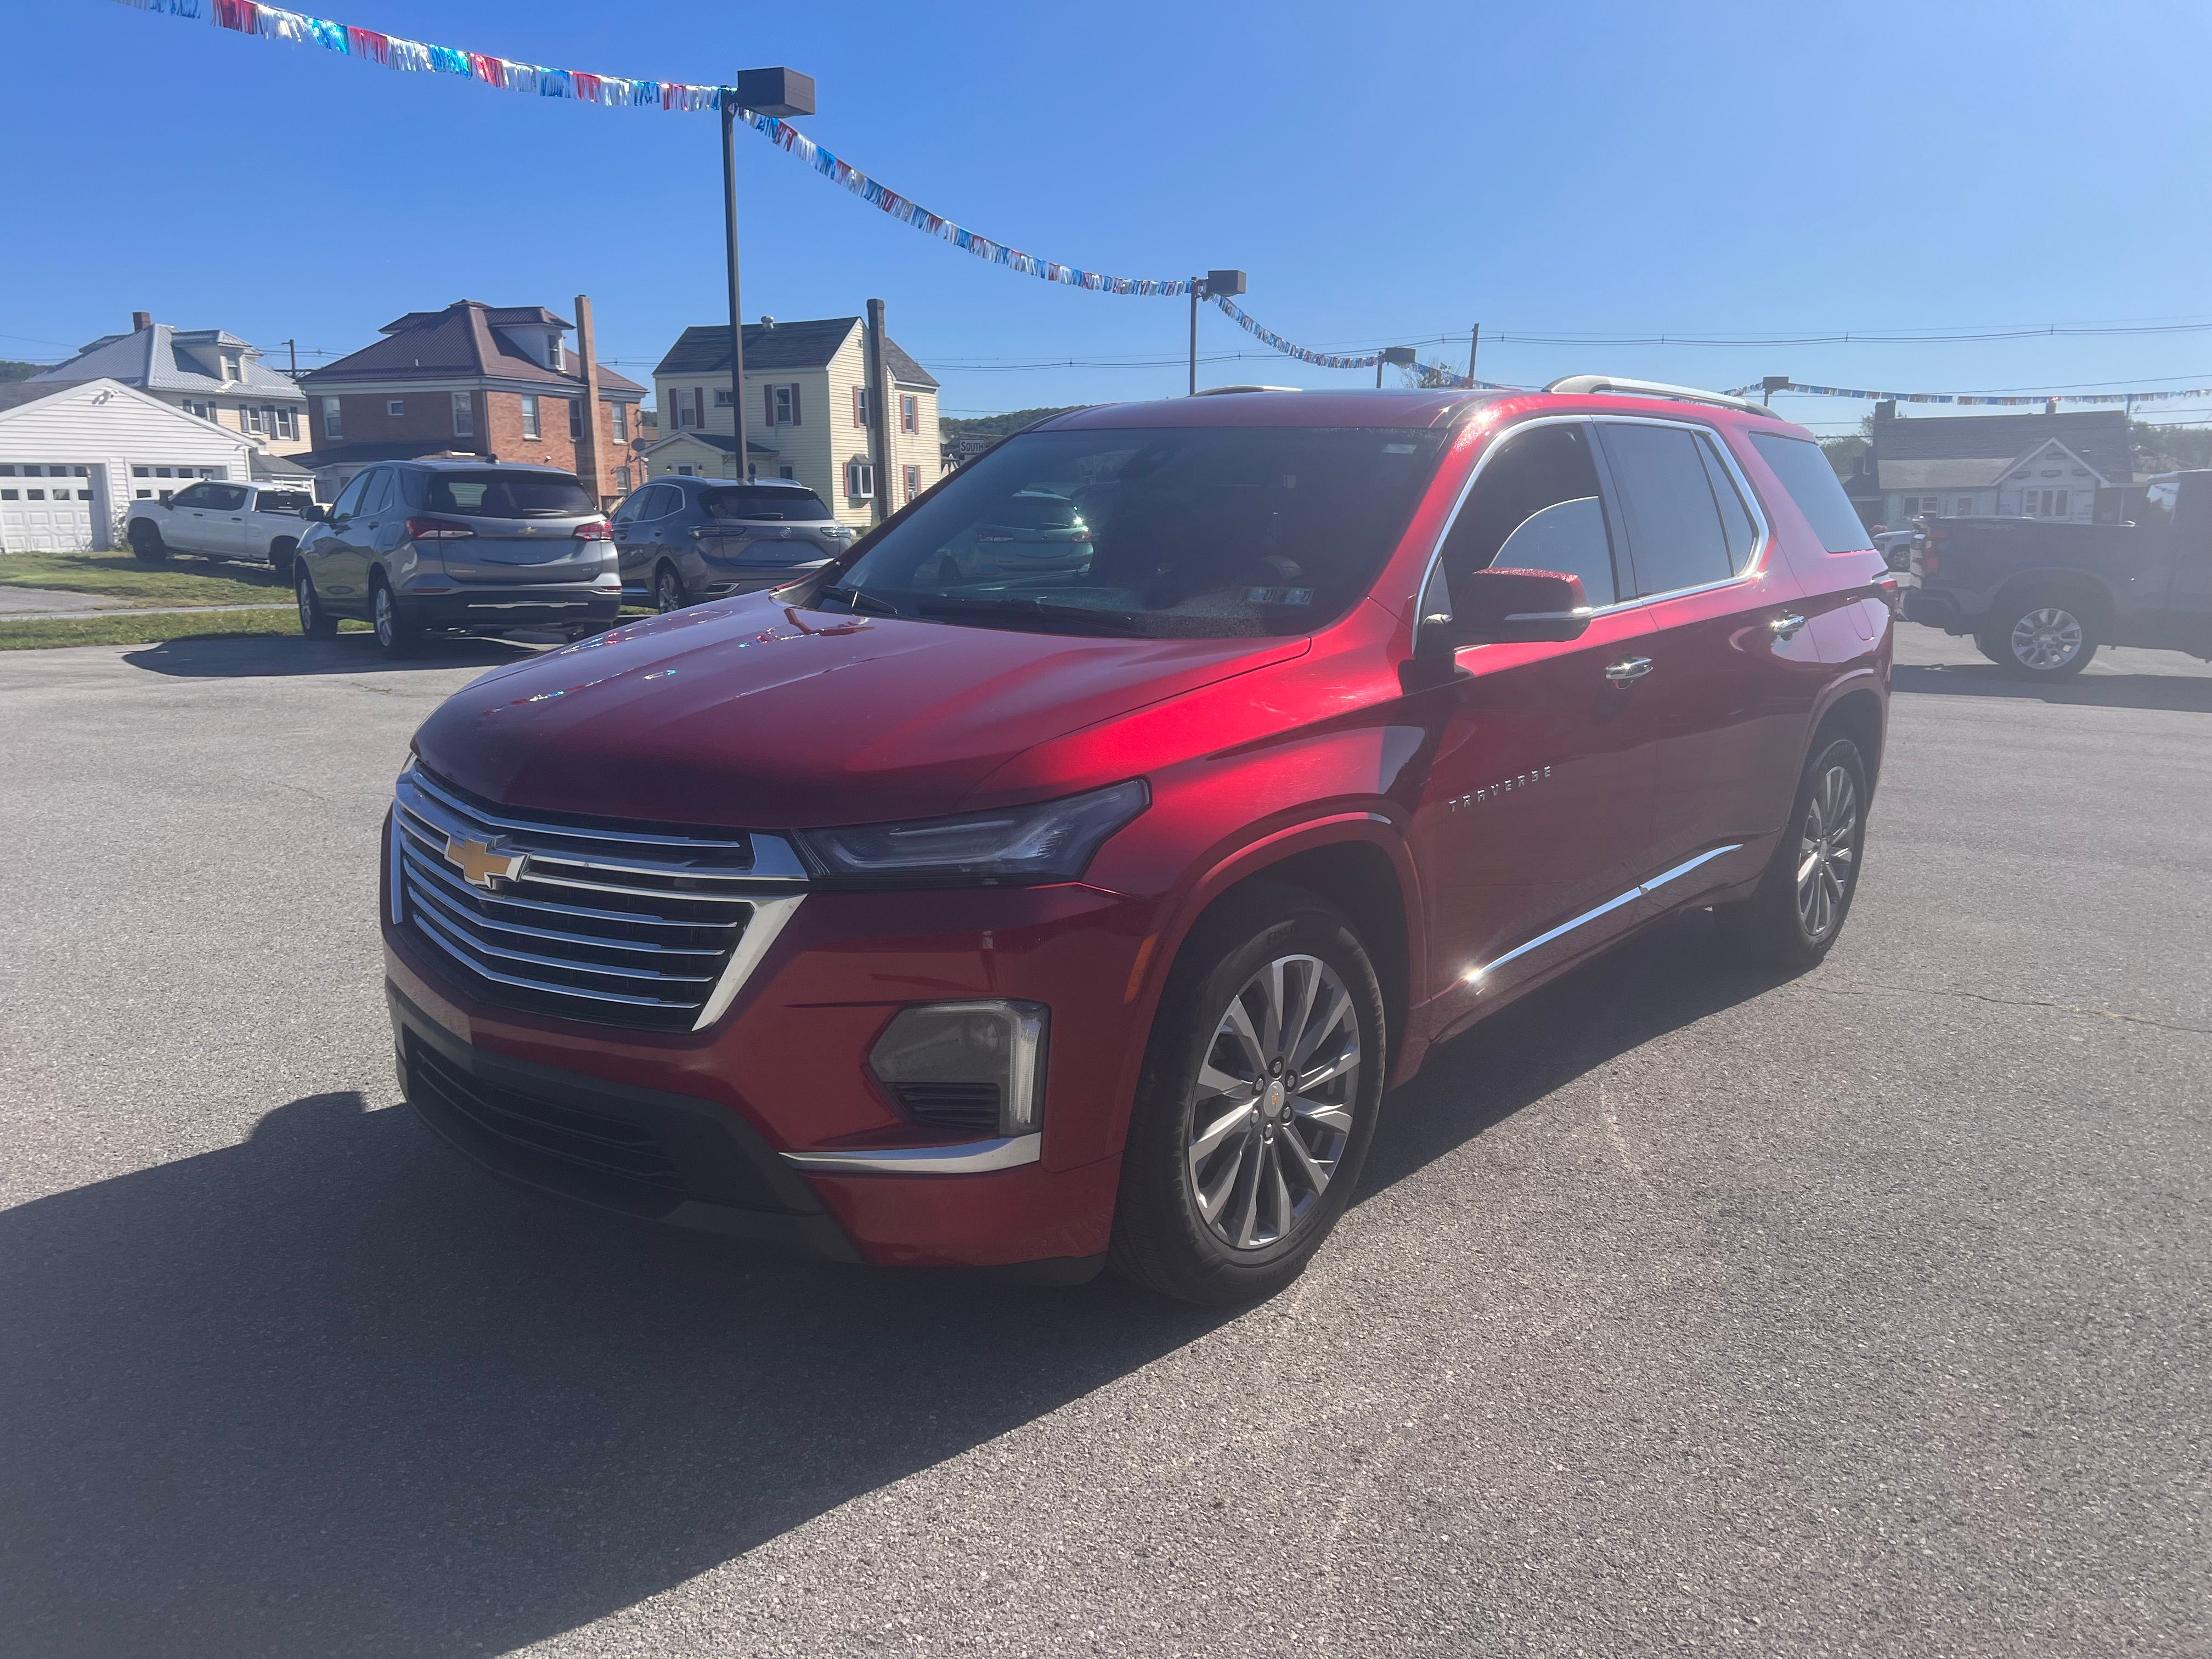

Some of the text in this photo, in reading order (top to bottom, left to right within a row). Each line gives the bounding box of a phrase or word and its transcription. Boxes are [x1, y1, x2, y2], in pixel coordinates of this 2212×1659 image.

[961, 441, 983, 452] SOUTH
[1263, 589, 1274, 601] 27
[1301, 591, 1312, 602] 27
[1449, 766, 1550, 812] TRAVERSE
